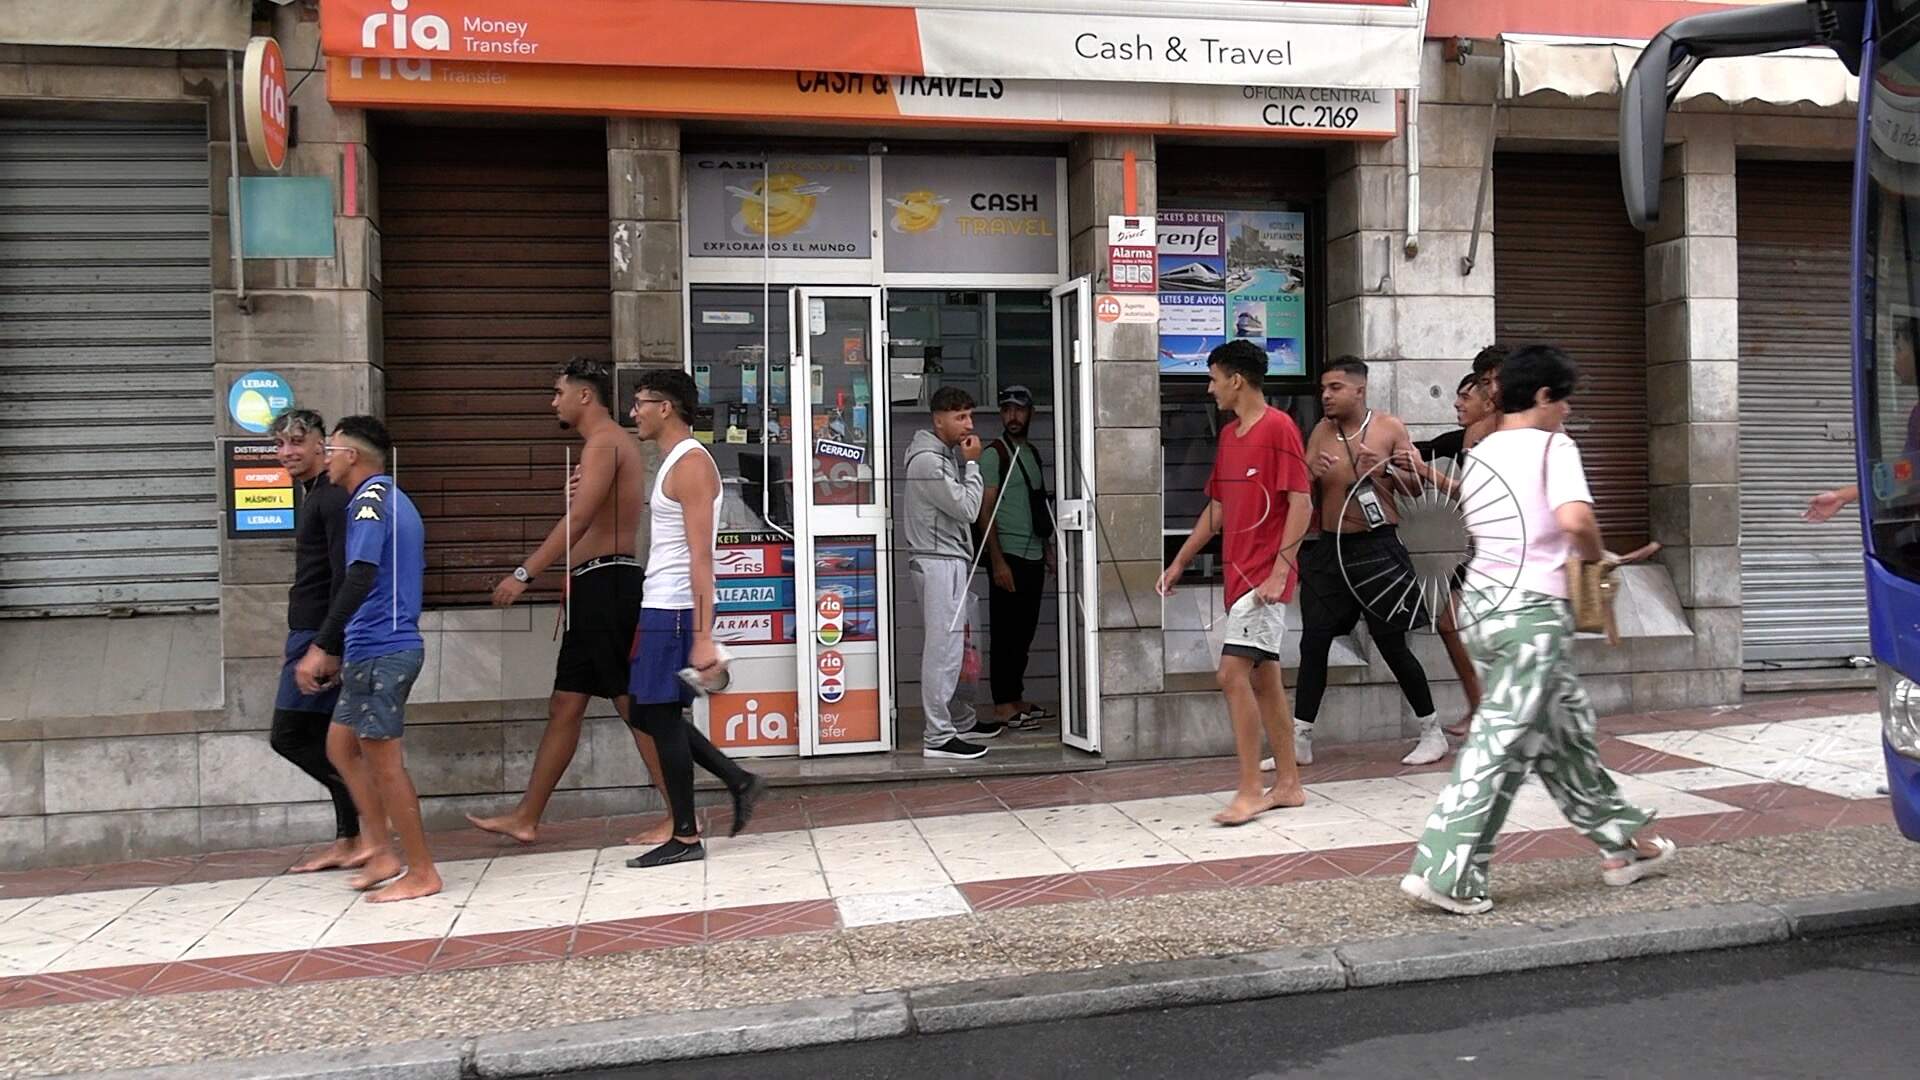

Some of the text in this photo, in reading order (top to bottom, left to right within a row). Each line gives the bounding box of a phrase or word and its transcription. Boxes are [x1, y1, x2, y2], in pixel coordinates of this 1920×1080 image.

[362, 0, 450, 51] ria
[463, 16, 528, 37] Money
[463, 36, 539, 54] Transfer
[1074, 32, 1293, 66] Cash & Travel
[262, 55, 285, 128] ria
[899, 75, 1004, 100] TRAVELS
[1242, 84, 1381, 104] OFICINA CENTRAL
[698, 160, 765, 170] CASH
[970, 193, 1038, 212] CASH
[1187, 213, 1199, 223] DE
[1201, 213, 1224, 223] TREN
[956, 216, 1056, 237] TRAVEL
[703, 241, 857, 253] EXPLORAMOS EL MUNDO
[1157, 227, 1218, 253] renfe
[1112, 247, 1153, 259] Alarma
[1098, 299, 1119, 314] ria
[1183, 295, 1195, 304] DE
[1196, 294, 1225, 304] AVIÓN
[242, 379, 279, 389] LEBARA
[820, 443, 861, 460] CERRADO
[245, 474, 280, 483] orange
[247, 515, 283, 525] LEBARA
[750, 534, 764, 543] DE
[734, 563, 763, 573] FRS
[820, 596, 841, 611] ria
[716, 618, 771, 630] ARMAS
[820, 655, 841, 668] ria
[725, 699, 789, 741] ria
